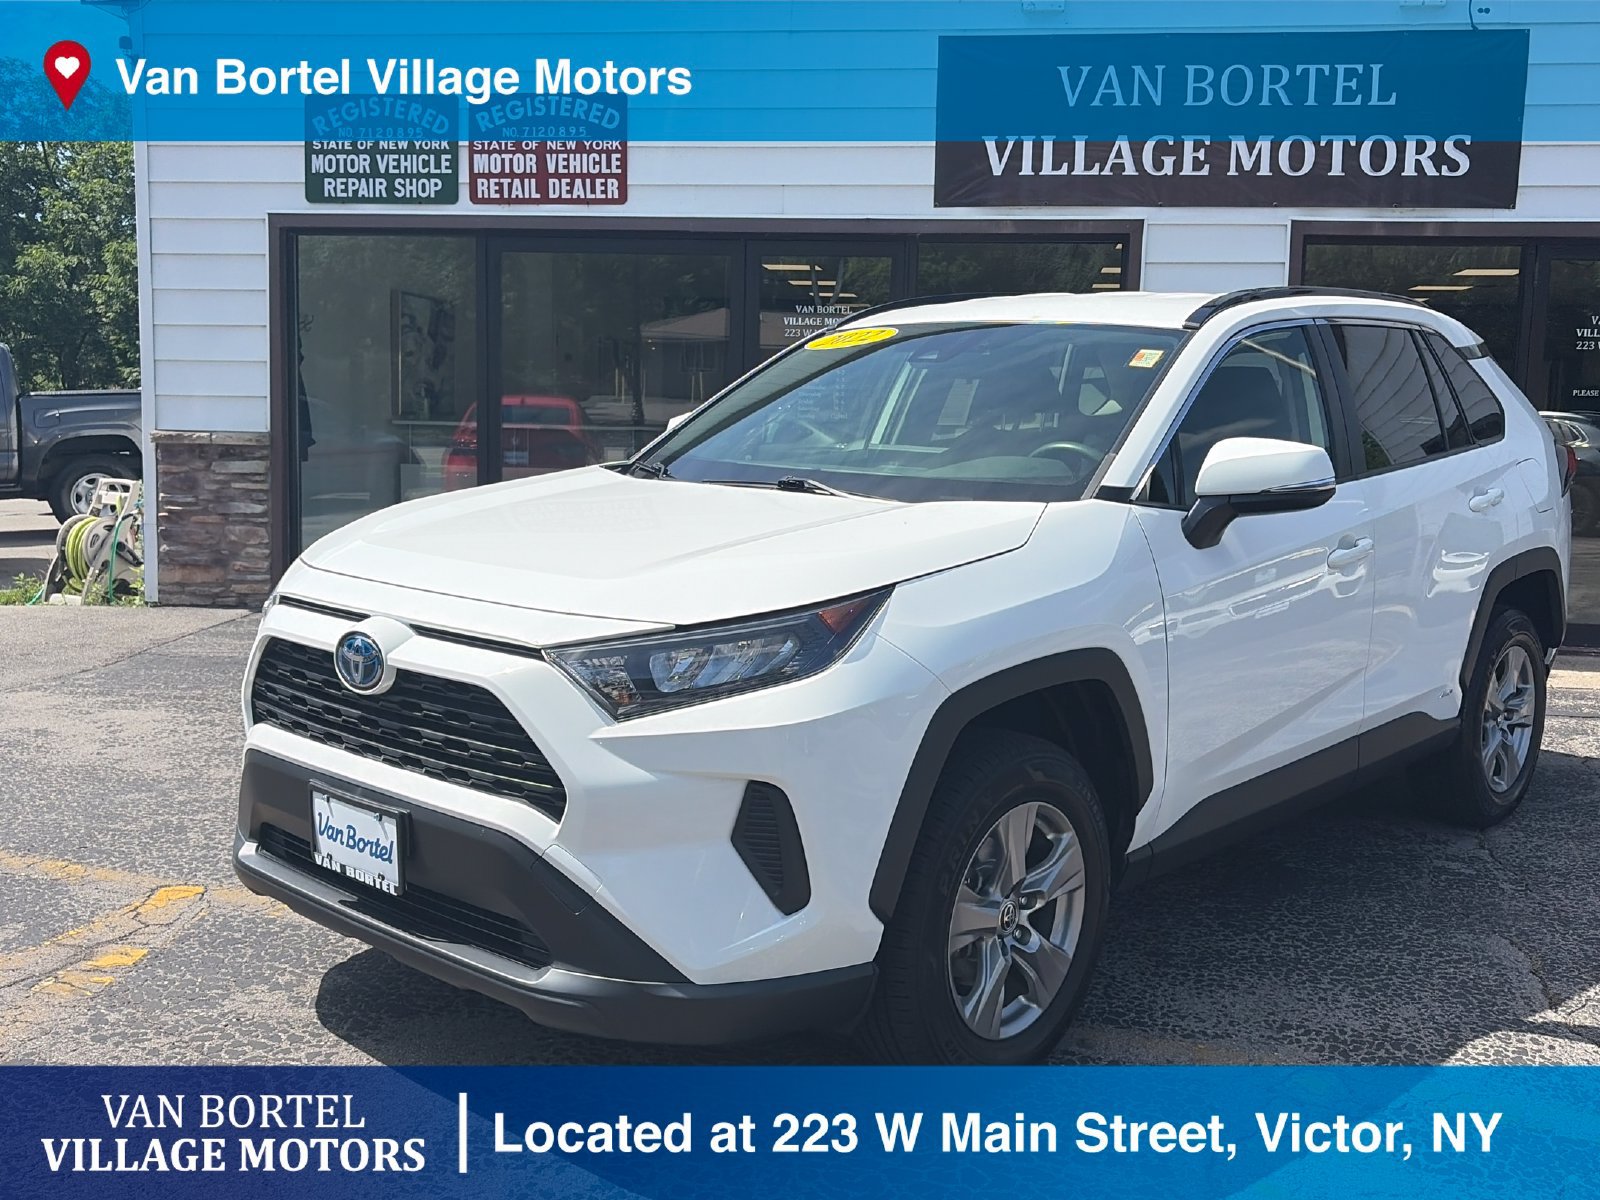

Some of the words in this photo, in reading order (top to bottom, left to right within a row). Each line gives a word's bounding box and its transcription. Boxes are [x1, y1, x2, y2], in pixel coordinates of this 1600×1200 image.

[1056, 64, 1166, 107] VAN
[1183, 63, 1397, 107] BORTEL
[312, 96, 450, 136] REGISTERED
[475, 95, 620, 133] REGISTERED
[360, 127, 424, 138] 7120895
[523, 126, 587, 138] 7120895
[312, 139, 353, 150] STATE
[357, 139, 376, 150] OF
[379, 139, 409, 150] NEW
[413, 139, 450, 150] YORK
[473, 140, 516, 151] STATE
[522, 140, 540, 151] OF
[546, 140, 577, 151] NEW
[583, 140, 622, 151] YORK
[473, 153, 537, 174] MOTOR
[546, 153, 622, 174] VEHICLE
[981, 134, 1211, 176] VILLAGE
[1226, 134, 1472, 177] MOTORS
[311, 154, 371, 174] MOTOR
[376, 154, 453, 174] VEHICLE
[323, 177, 388, 198] REPAIR
[393, 178, 443, 198] SHOP
[477, 178, 541, 199] RETAIL
[549, 178, 619, 199] DEALER
[795, 304, 815, 314] VAN
[817, 305, 853, 314] BORTEL
[783, 316, 823, 326] VILLAGE
[784, 328, 801, 337] 223
[1576, 341, 1595, 350] 223
[1572, 389, 1600, 397] PLEASE
[314, 852, 341, 873] VAN
[345, 865, 398, 896] BORTEL
